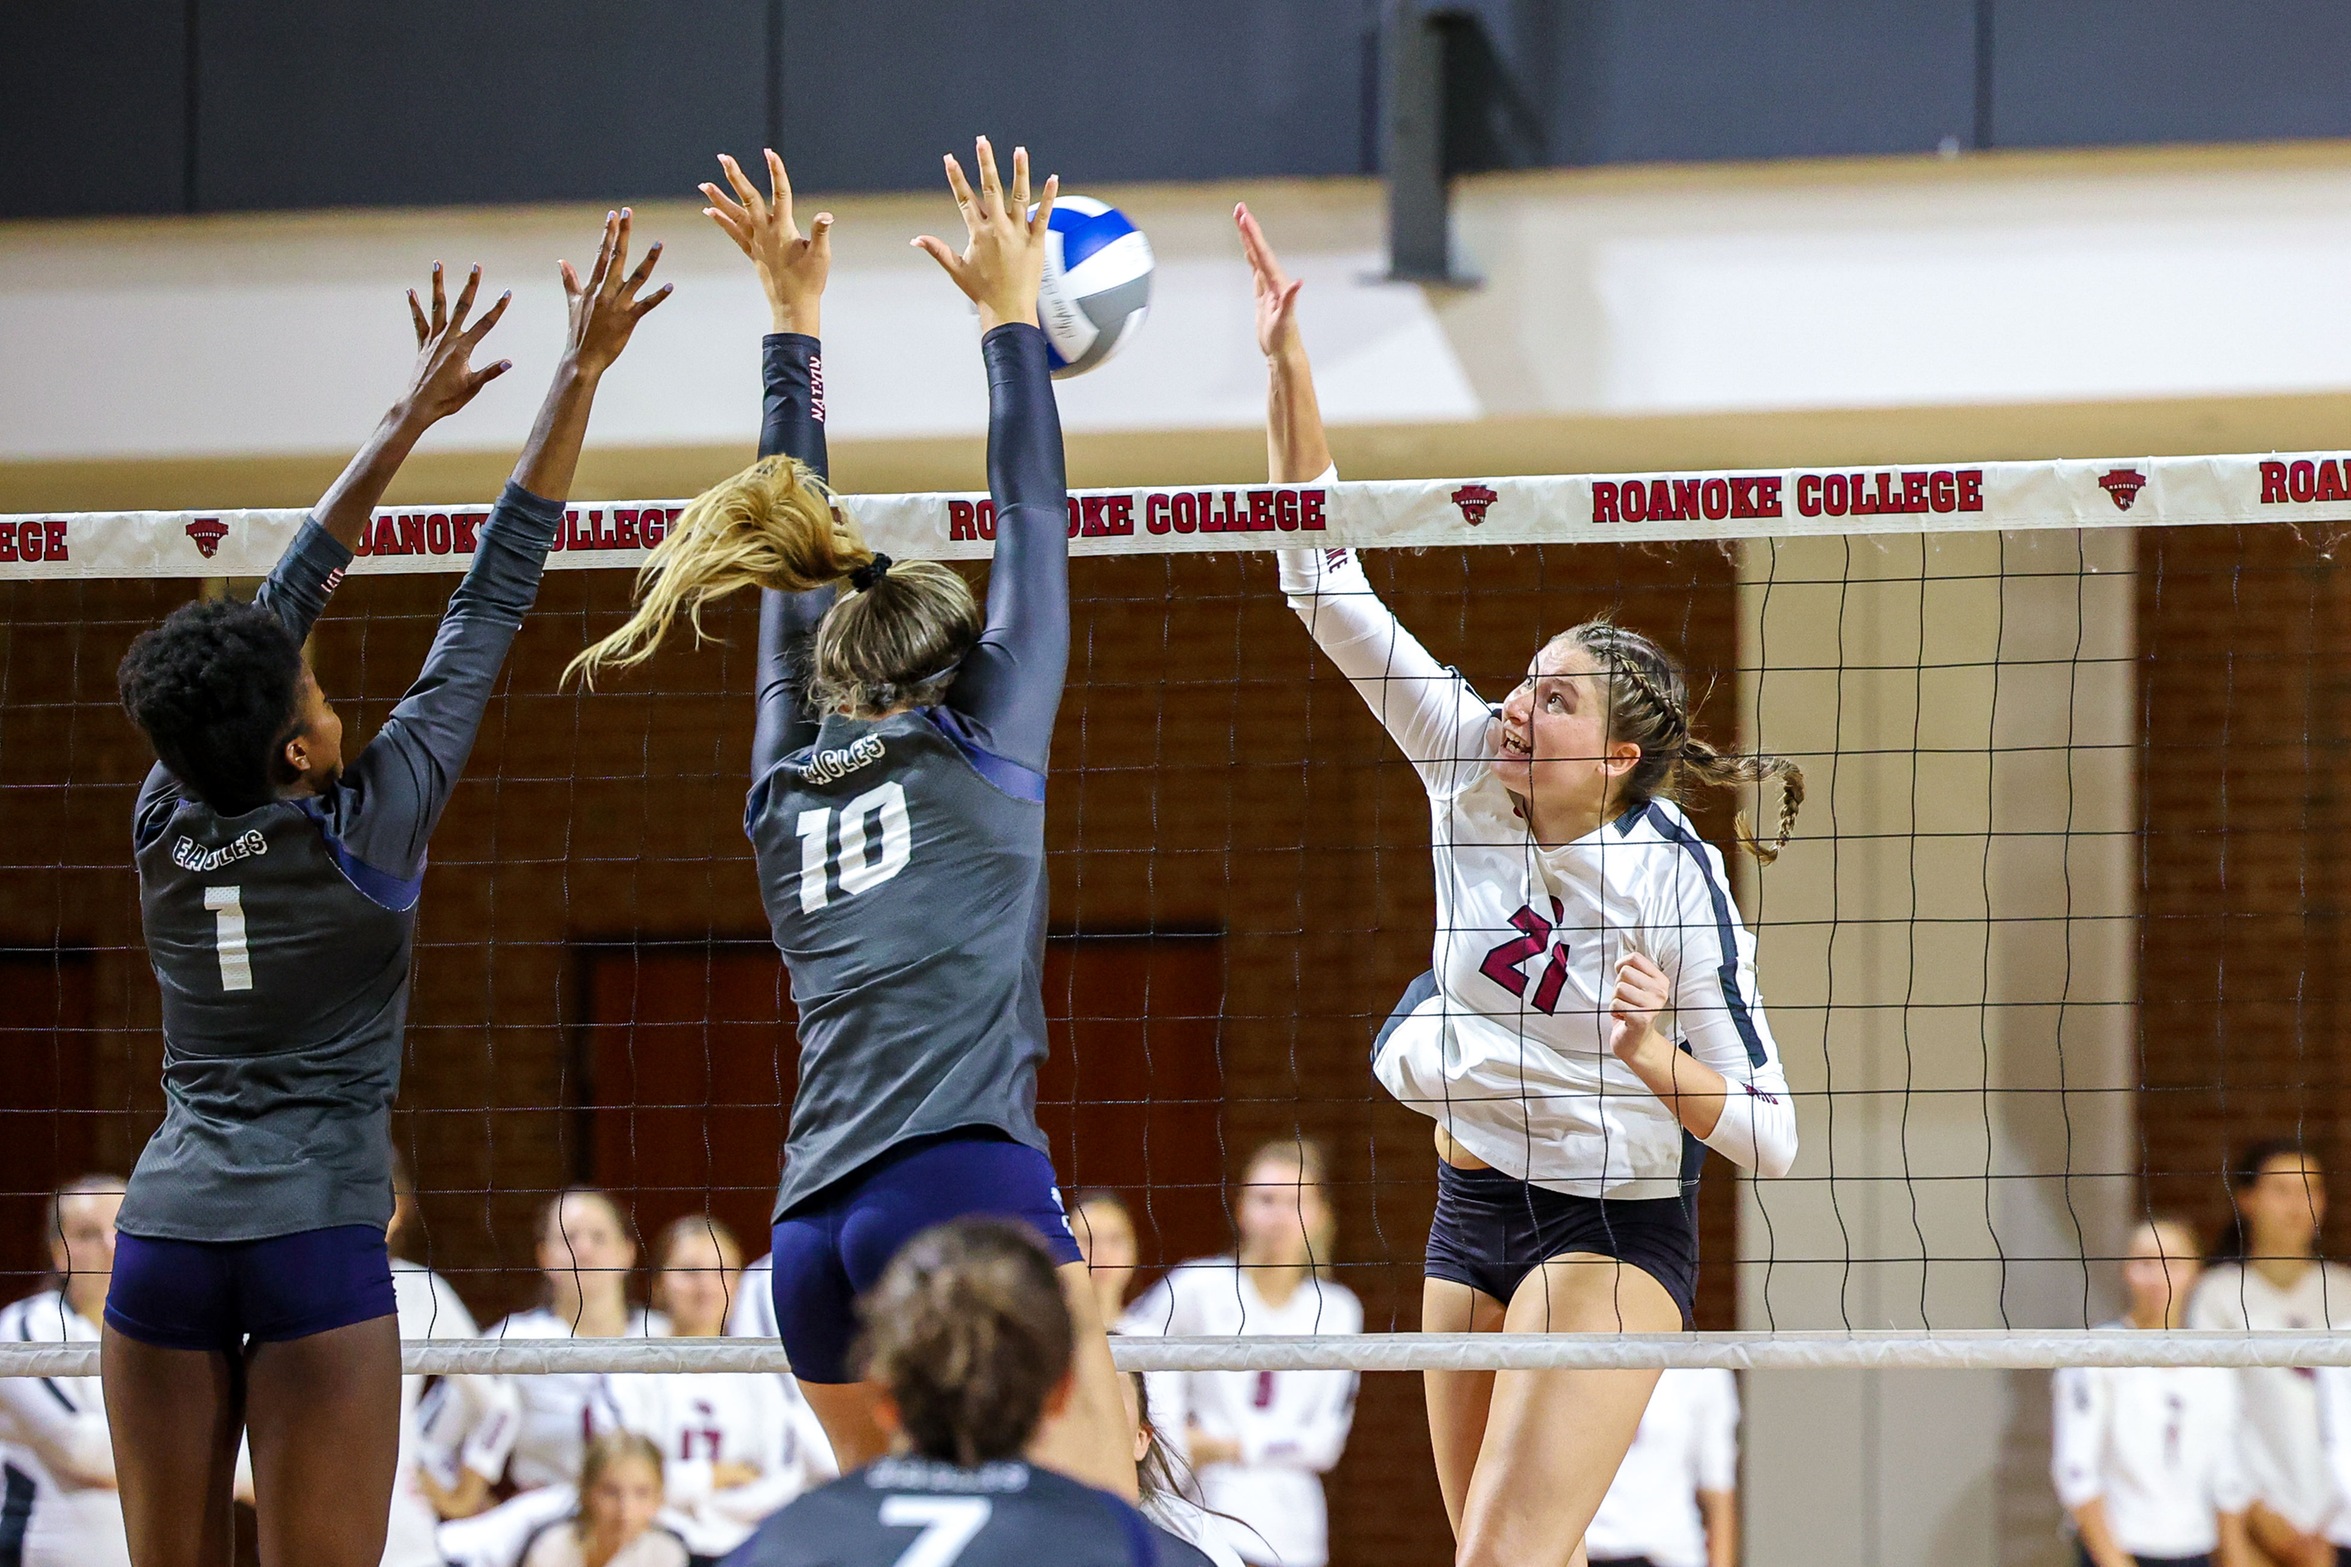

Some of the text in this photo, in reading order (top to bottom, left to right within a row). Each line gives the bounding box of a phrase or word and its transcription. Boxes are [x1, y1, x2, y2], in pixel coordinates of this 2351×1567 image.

[948, 489, 1327, 541] ROOKE COLLEGE
[1592, 470, 1983, 523] ROANOKE COLLEGE
[354, 508, 686, 557] ANOK LLEG
[172, 829, 268, 872] EAGLES
[796, 780, 912, 915] 10
[204, 885, 253, 991] 1
[1479, 894, 1570, 1017] 21
[878, 1493, 993, 1567] 7
